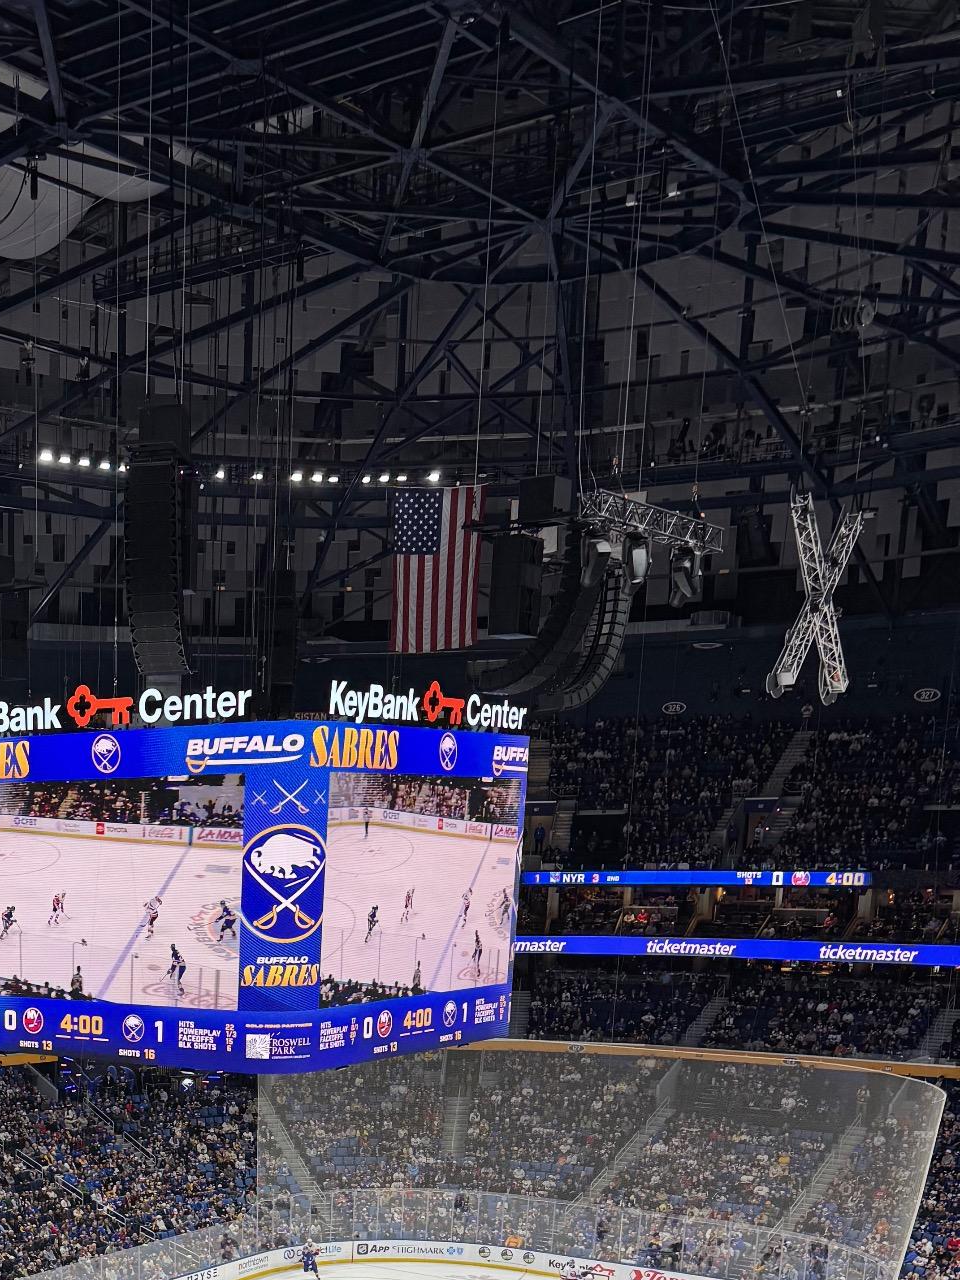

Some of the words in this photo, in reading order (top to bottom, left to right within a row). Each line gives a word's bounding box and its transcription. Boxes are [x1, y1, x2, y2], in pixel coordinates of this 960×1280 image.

[920, 690, 934, 699] 327
[138, 686, 253, 723] Center
[329, 679, 420, 724] KeyBank
[466, 693, 528, 730] Center
[186, 734, 305, 756] BUFFALO
[310, 725, 400, 770] SABRES
[493, 745, 529, 762] BUFFA
[562, 874, 585, 883] NYR
[592, 874, 599, 883] 3
[772, 872, 783, 886] 0
[825, 873, 865, 885] 4:00
[646, 939, 737, 957] ticketmaster
[819, 944, 918, 963] ticketmaster
[257, 956, 308, 964] BUFFALO
[241, 963, 320, 987] SABRES
[462, 1002, 468, 1022] 1
[4, 1009, 17, 1031] 0
[60, 1013, 103, 1035] 4:00
[179, 1020, 194, 1028] HITS
[403, 1008, 432, 1029] 4:00
[320, 1021, 331, 1029] HITS
[320, 1025, 348, 1036] POWERPLAY
[363, 1017, 373, 1039] 0
[154, 1020, 163, 1043] 1
[179, 1028, 221, 1037] POWERPLAY
[455, 1031, 462, 1040] 16
[179, 1035, 214, 1043] FACEOFFS
[272, 1037, 311, 1046] ROSWELL
[320, 1033, 344, 1043] FACEOFFS
[19, 1040, 39, 1048] SHOTS
[42, 1040, 52, 1051] 13
[179, 1041, 192, 1049] BLK
[329, 1040, 344, 1049] SHOTS
[373, 1045, 388, 1054] SHOTS
[390, 1042, 397, 1052] 13
[118, 1048, 140, 1057] SHOTS
[143, 1049, 155, 1060] 16
[272, 1047, 296, 1055] PARK
[397, 1246, 444, 1254] HIGHMARK
